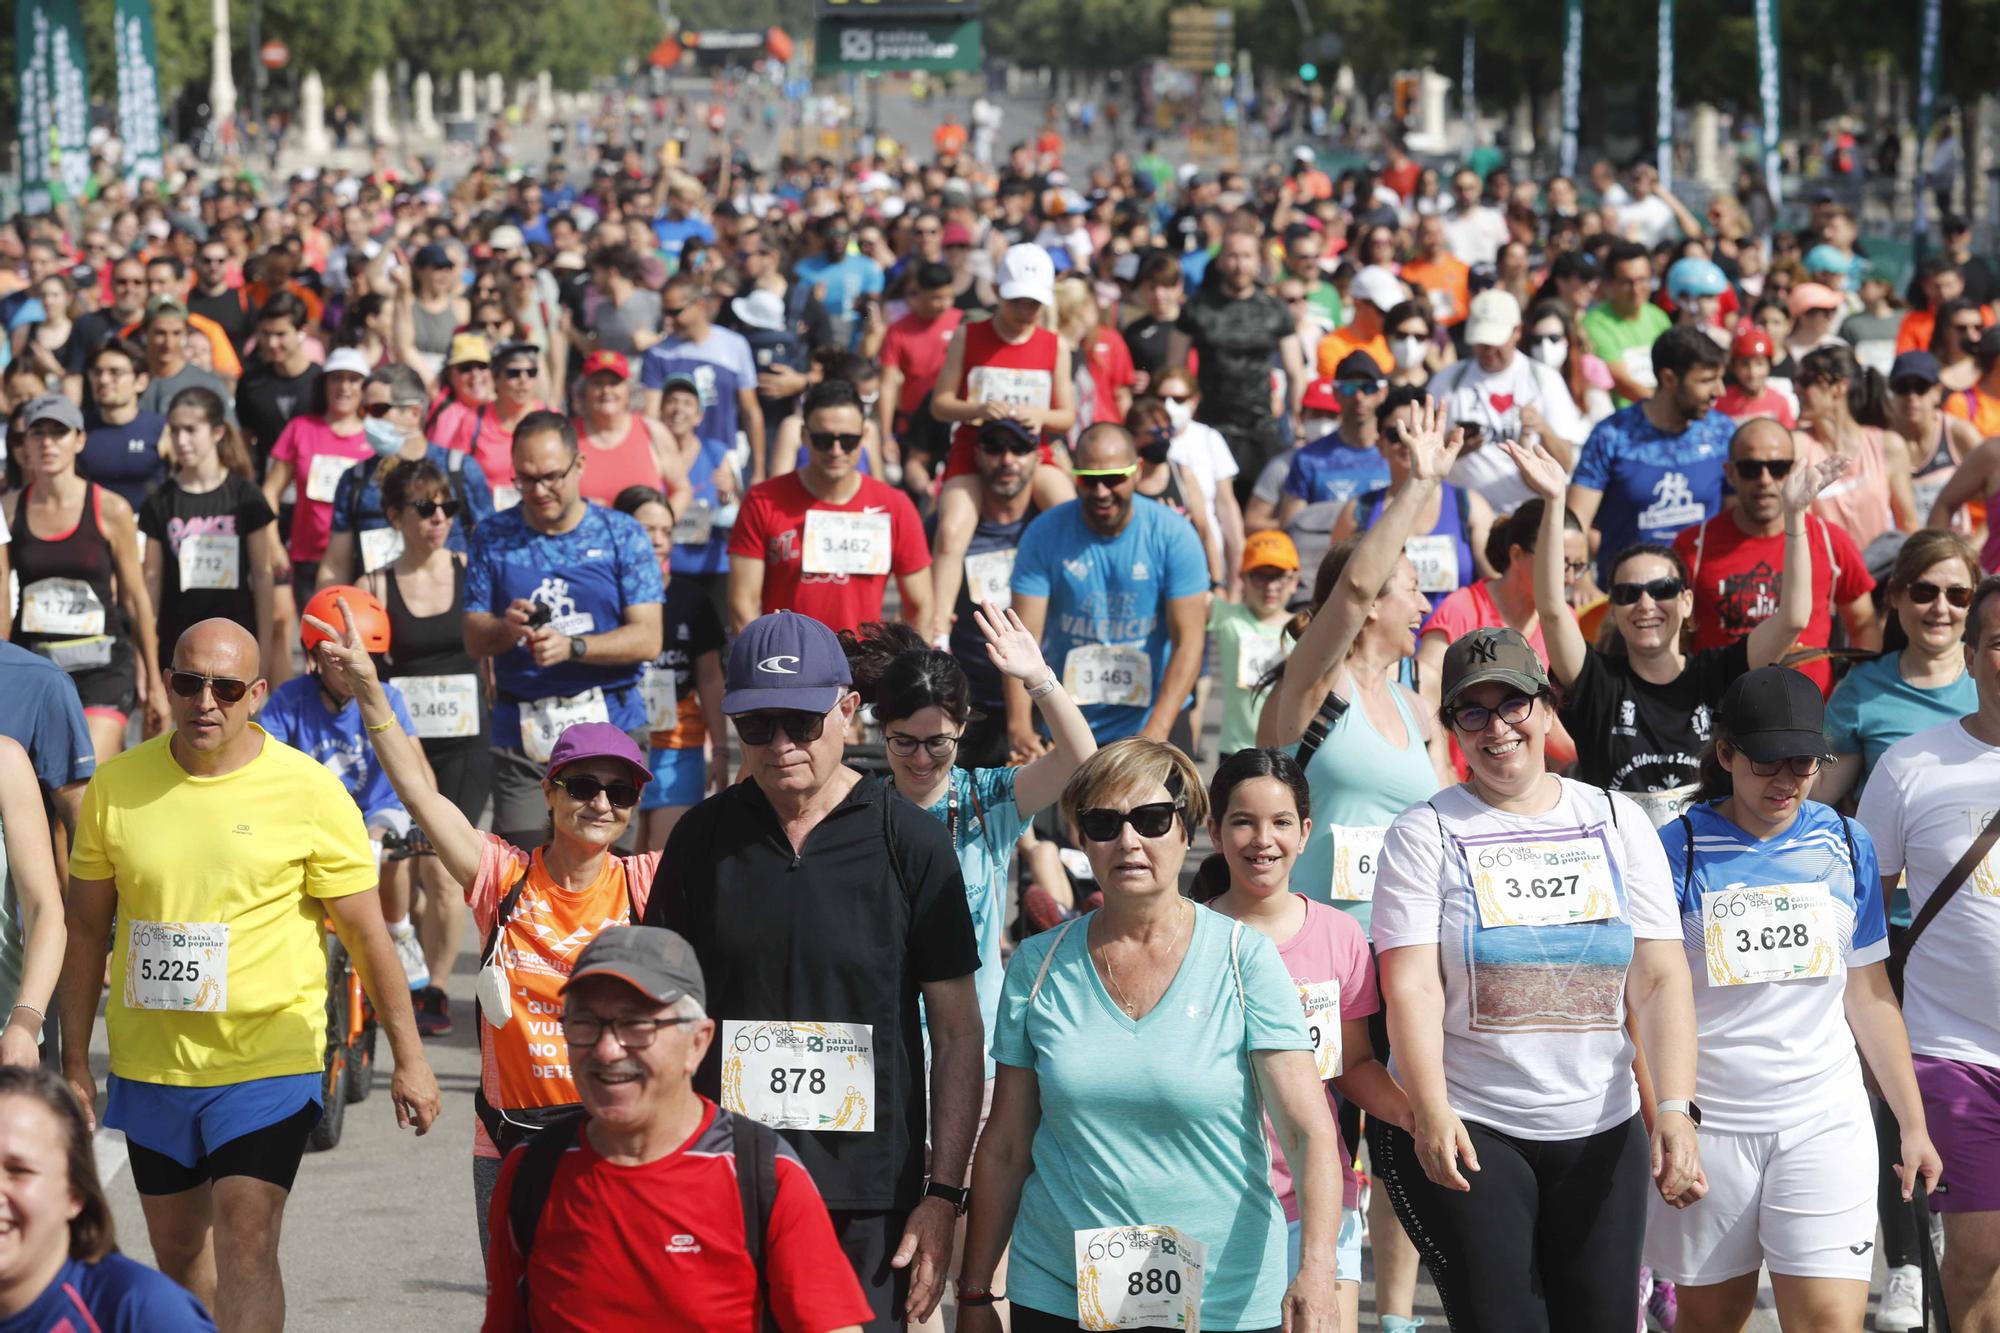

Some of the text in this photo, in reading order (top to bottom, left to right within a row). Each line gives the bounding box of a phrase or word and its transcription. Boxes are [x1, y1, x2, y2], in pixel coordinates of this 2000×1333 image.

[822, 537, 871, 553] 3.462
[1083, 669, 1133, 685] 3.463
[411, 701, 459, 718] 3.465
[1479, 846, 1512, 868] 66
[1562, 855, 1600, 865] popular
[1505, 875, 1580, 899] 3.627
[1713, 893, 1746, 918] 66
[134, 925, 150, 946] 66
[188, 940, 224, 948] popular
[1736, 923, 1809, 953] 3.628
[141, 959, 200, 982] 5.225
[1309, 996, 1329, 1005] caixa
[735, 1026, 770, 1051] 66
[826, 1036, 854, 1045] caixa
[826, 1044, 869, 1053] popular
[527, 1043, 557, 1057] NO
[770, 1067, 826, 1095] 878
[1088, 1232, 1125, 1260] 66
[1127, 1268, 1182, 1296] 880
